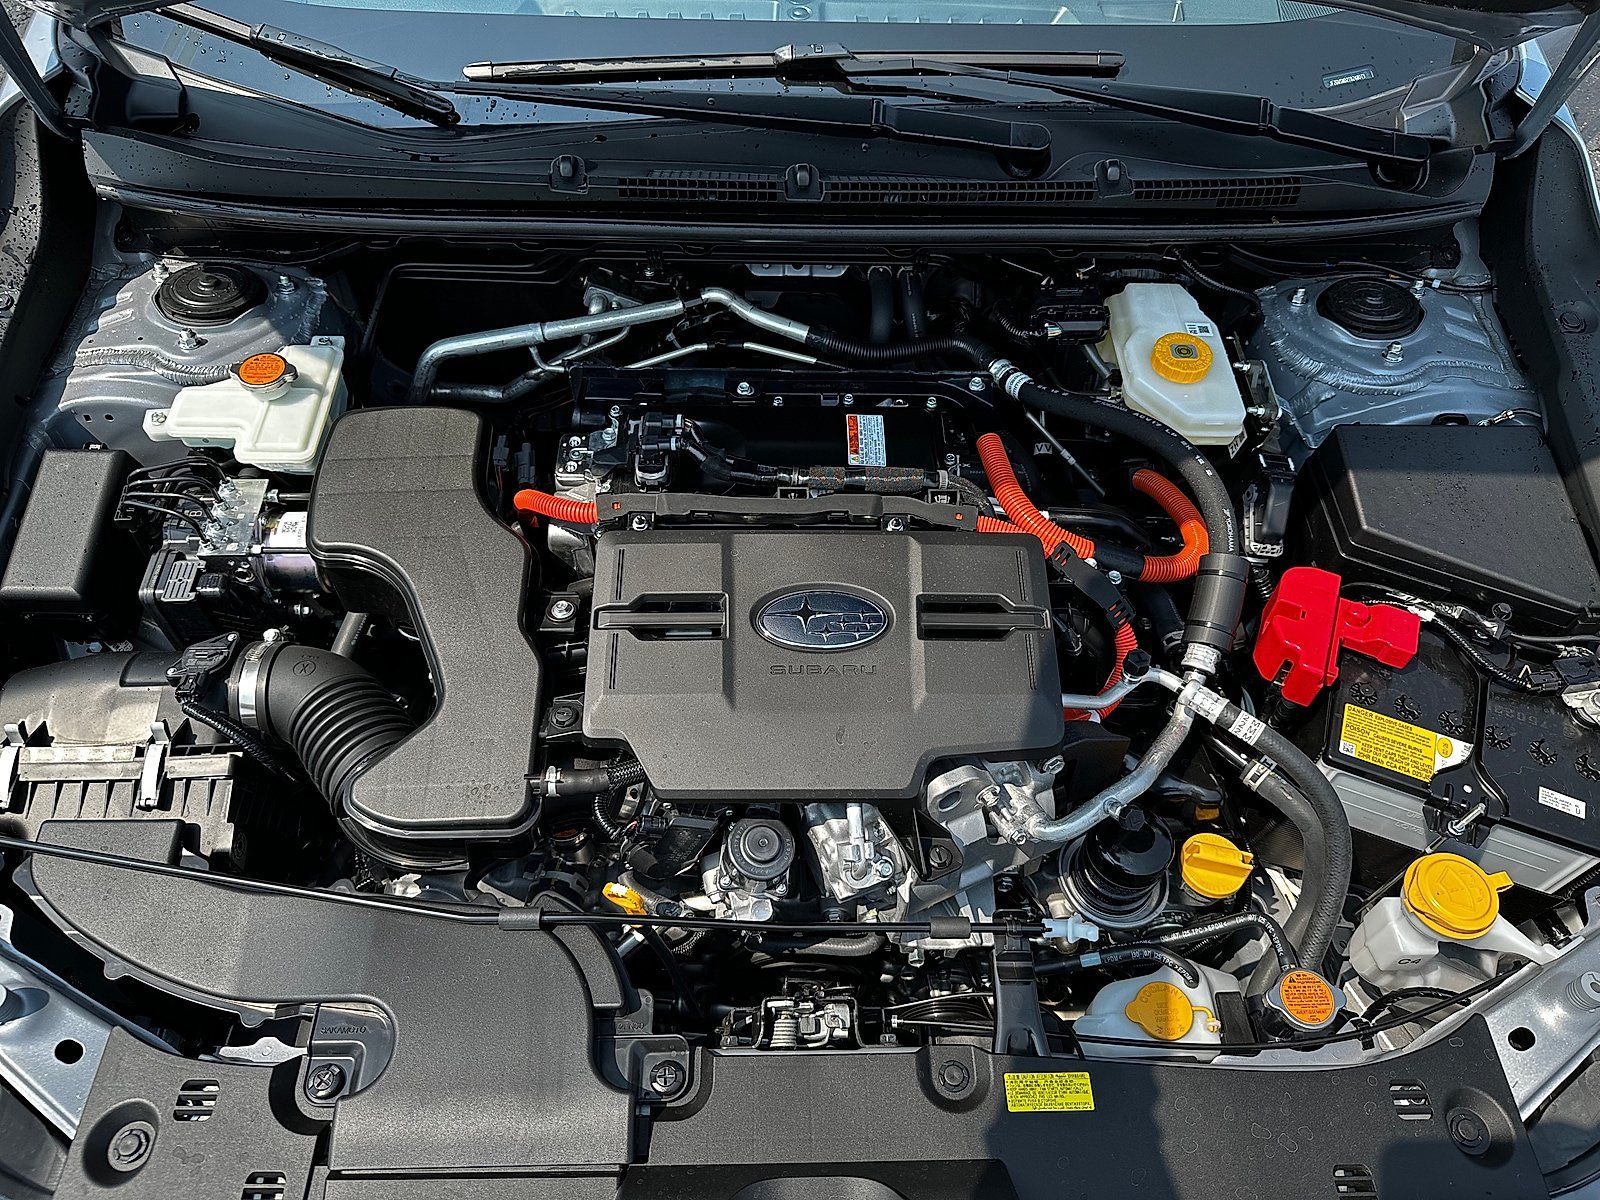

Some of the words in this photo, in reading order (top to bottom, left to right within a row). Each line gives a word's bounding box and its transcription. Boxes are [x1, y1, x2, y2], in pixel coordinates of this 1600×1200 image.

[769, 664, 877, 675] SUBARU
[1347, 705, 1374, 718] DANGER
[1375, 714, 1398, 727] EXPLOSIVE
[1345, 723, 1371, 736] POISON
[1373, 733, 1390, 744] CAUSES
[1390, 738, 1408, 749] SEVERE
[1408, 743, 1423, 753] BURNS
[320, 1025, 367, 1035] SAKAMOTO
